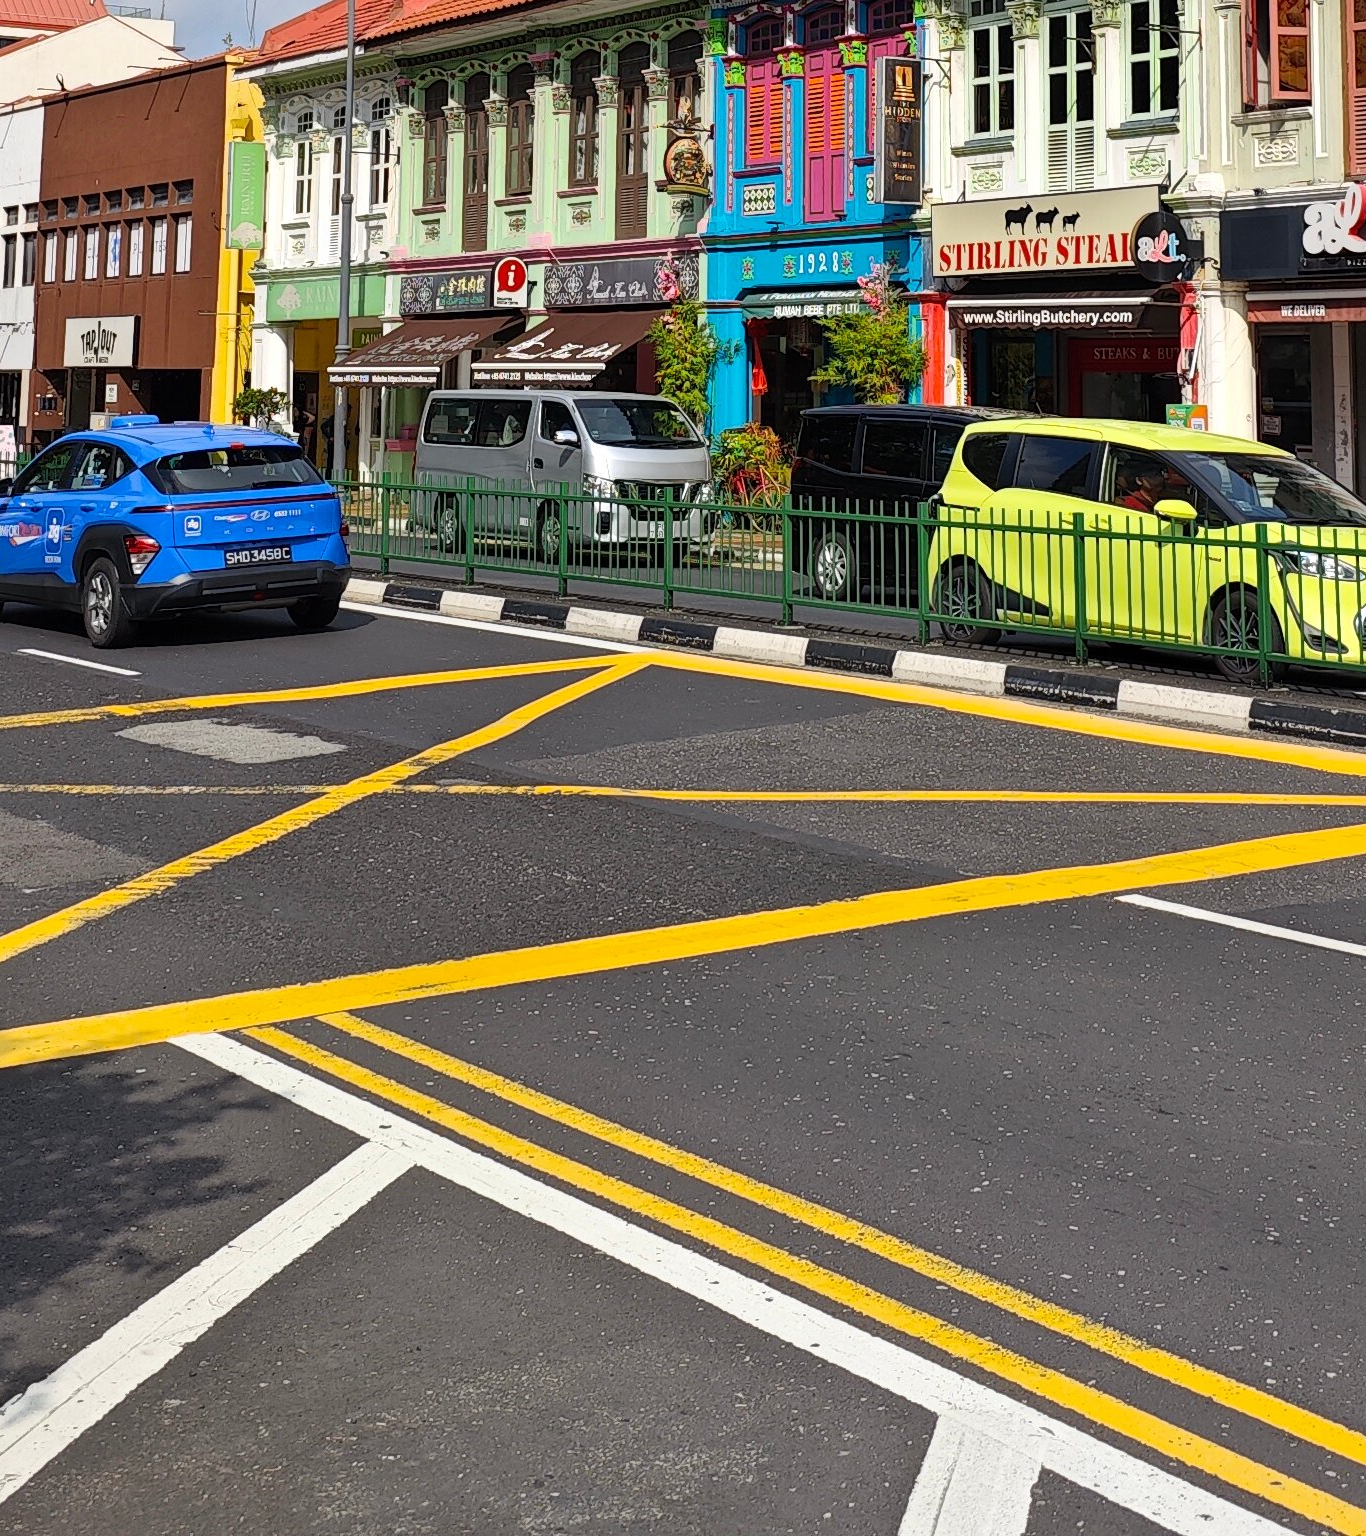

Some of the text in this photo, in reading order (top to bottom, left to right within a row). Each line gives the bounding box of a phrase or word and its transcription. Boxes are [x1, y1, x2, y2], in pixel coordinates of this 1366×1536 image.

[885, 106, 920, 117] HIDDEN
[939, 237, 1048, 272] STIRLING
[799, 251, 839, 274] 1928
[774, 303, 859, 316] RUMAH BEBE PTE LTD
[1281, 304, 1325, 317] WE DELIVER
[963, 310, 1133, 326] www.StirlingButchery.com
[81, 328, 117, 356] TAP OUT
[1093, 347, 1136, 360] STEAKS
[1142, 348, 1151, 360] &
